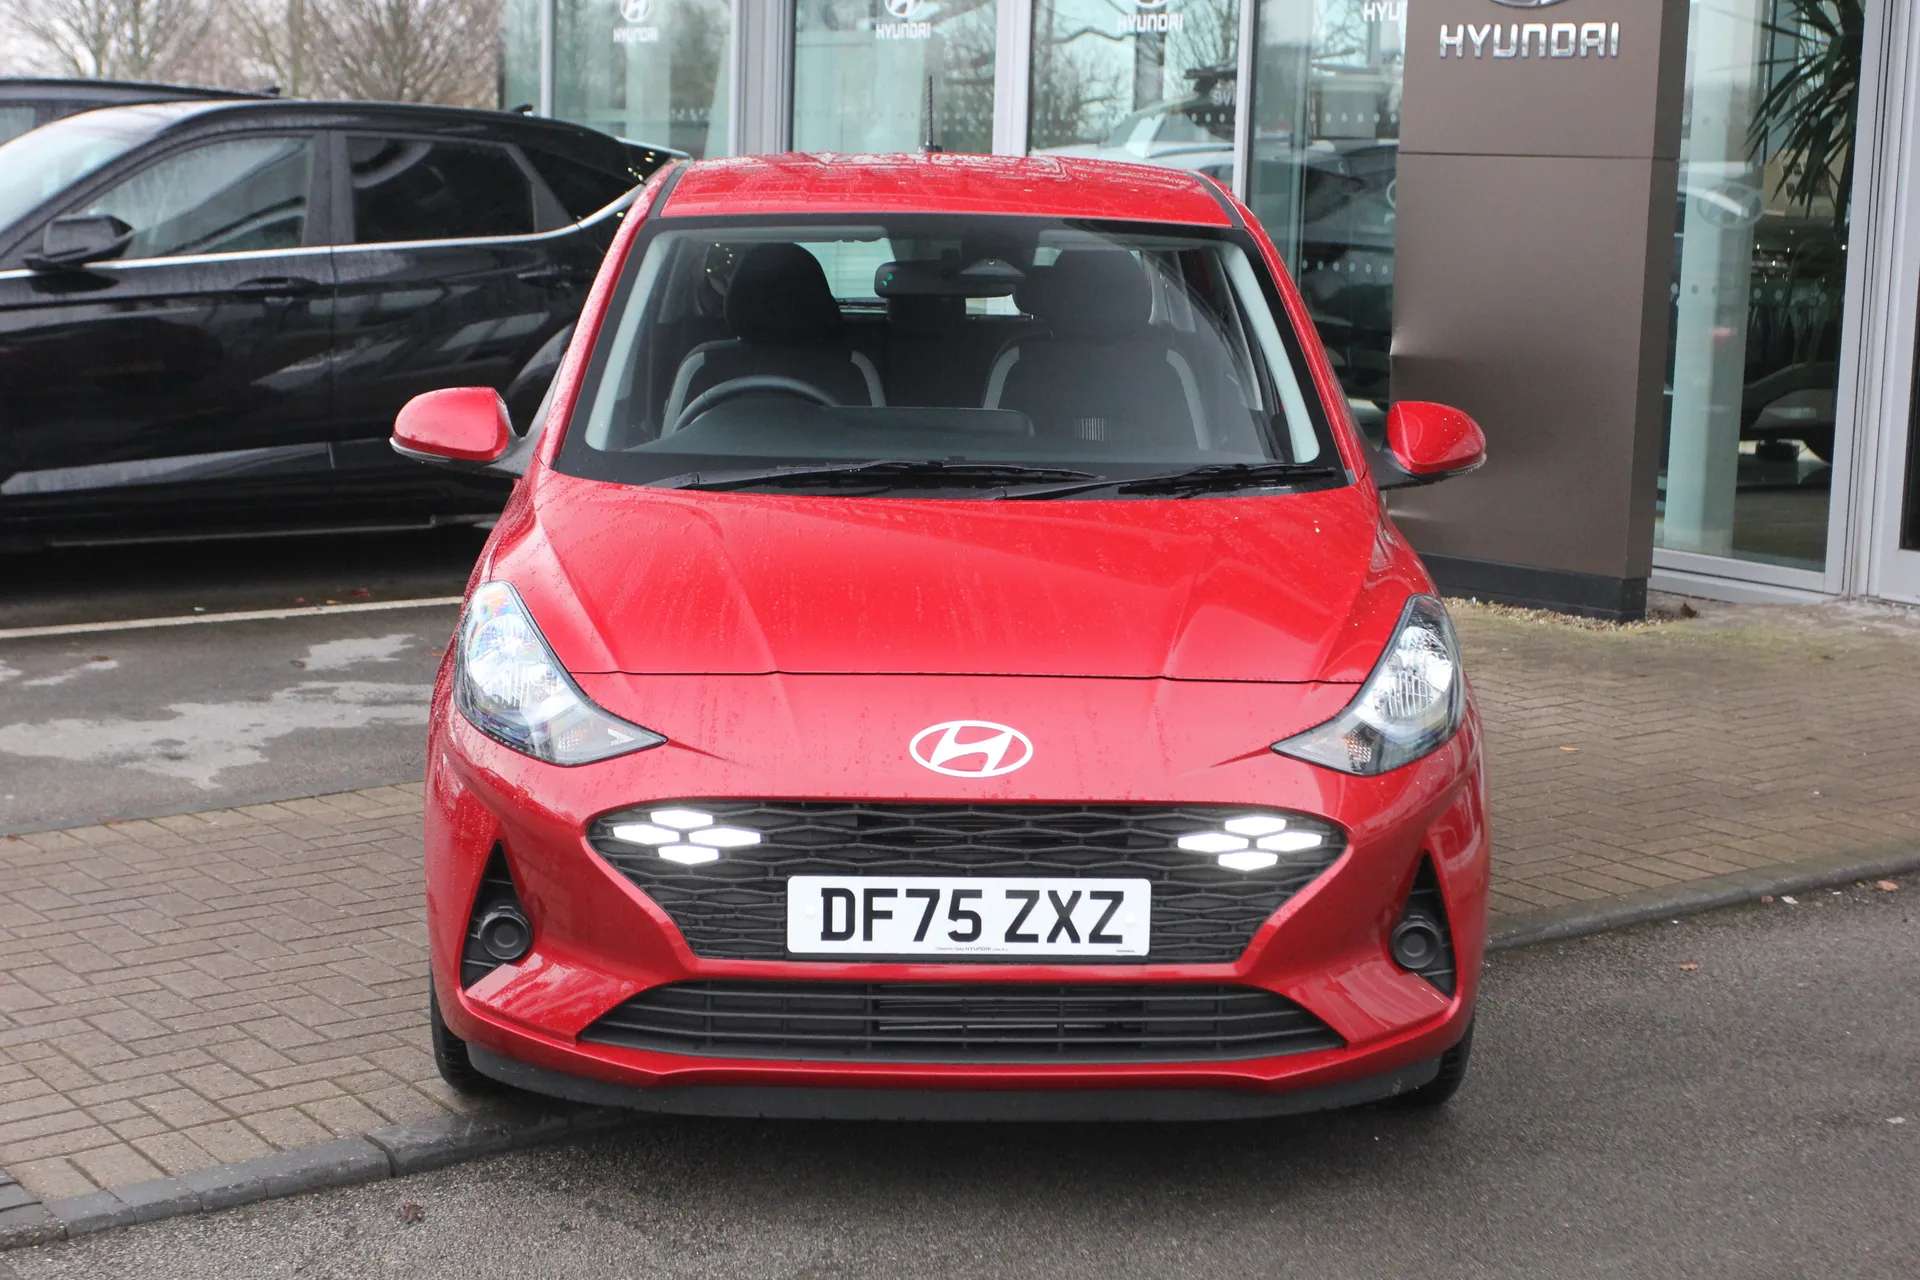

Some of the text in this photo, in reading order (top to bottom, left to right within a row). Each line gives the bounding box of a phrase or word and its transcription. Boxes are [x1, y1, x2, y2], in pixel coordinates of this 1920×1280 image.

[876, 23, 931, 39] HYUNDAI
[1120, 13, 1184, 32] HYUNDAI
[613, 27, 658, 42] HYUNDAI
[1439, 22, 1620, 59] HYUNDAI
[820, 887, 1125, 944] DF75 ZXZ
